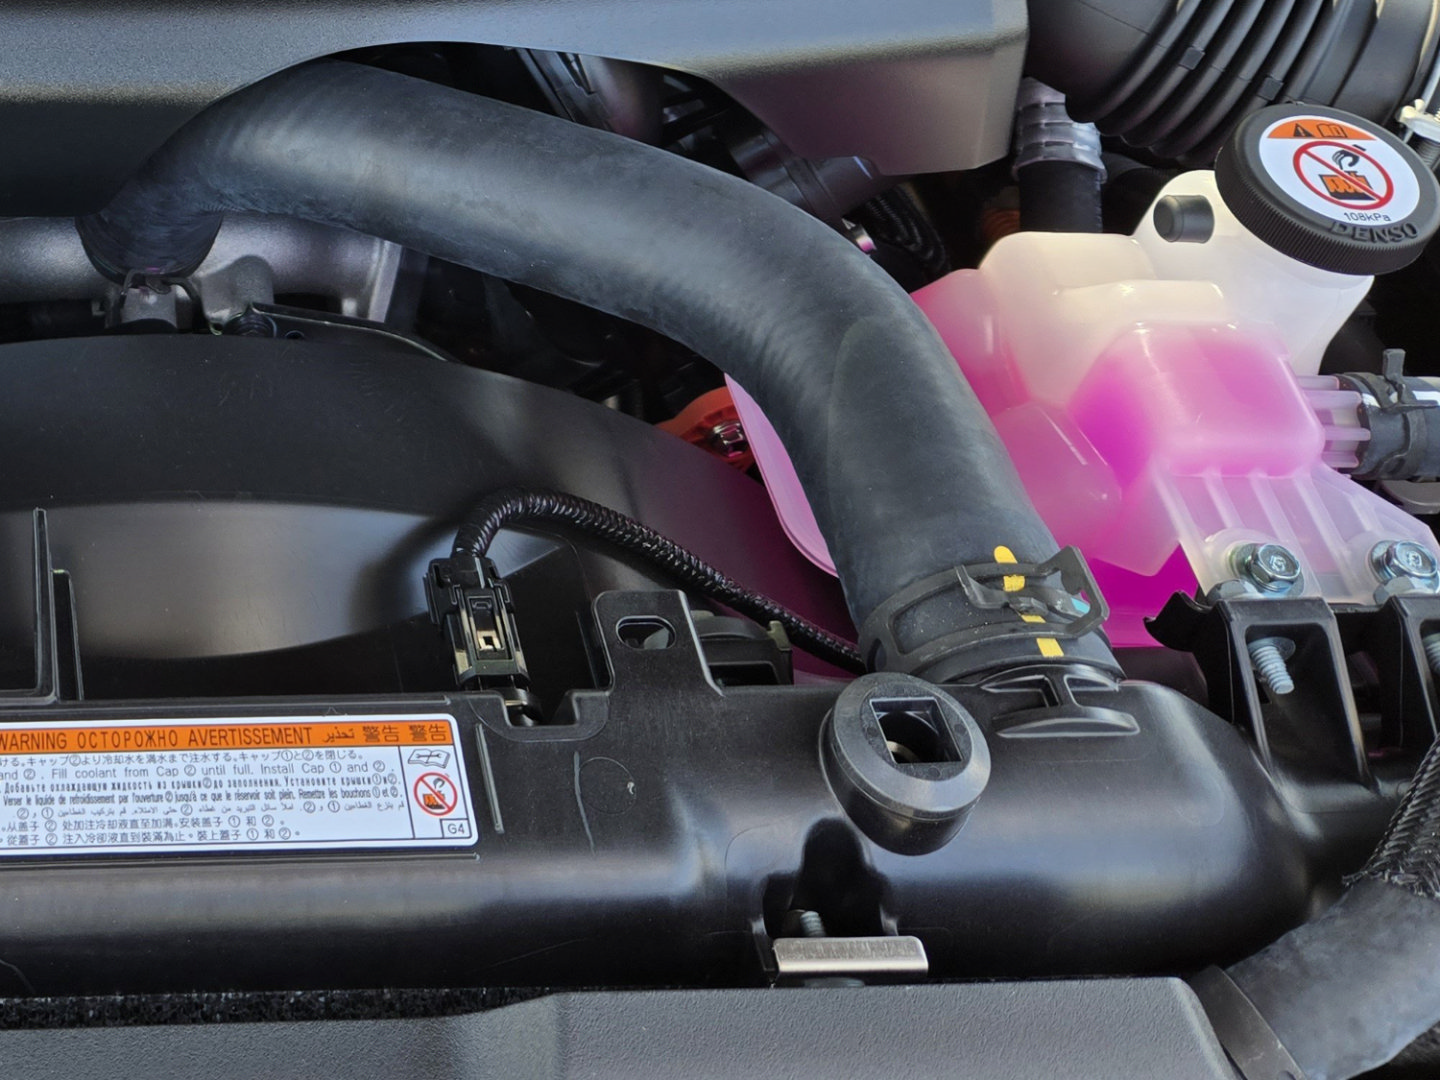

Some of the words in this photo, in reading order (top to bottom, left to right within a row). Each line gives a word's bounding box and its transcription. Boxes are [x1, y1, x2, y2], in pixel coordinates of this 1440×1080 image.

[1343, 212, 1391, 221] 108kPa
[1330, 221, 1419, 243] DENSO
[76, 729, 178, 749] ОСТОРОЖНО
[186, 726, 314, 747] AVERTISSEMENT
[361, 724, 401, 743] 警告
[407, 723, 448, 742] 警告
[51, 768, 68, 779] Fill
[74, 766, 117, 779] coolant
[123, 766, 149, 778] from
[155, 765, 179, 778] Cap
[200, 764, 226, 776] until
[232, 763, 254, 775] full.
[259, 762, 294, 774] Install
[300, 762, 325, 775] Cap
[345, 761, 369, 772] and
[2, 795, 23, 806] Verser
[25, 795, 31, 806] le
[34, 794, 55, 806] liquide
[57, 794, 66, 805] de
[68, 793, 115, 805] refroidissement
[117, 794, 129, 805] par
[198, 790, 208, 801] ce
[210, 791, 223, 802] que
[224, 790, 231, 801] le
[262, 789, 276, 800] soit
[277, 788, 296, 800] plein.
[297, 788, 325, 799] Remettre
[327, 787, 338, 798] les
[339, 786, 372, 798] bouchons
[380, 786, 389, 797] et
[446, 822, 465, 834] G4
